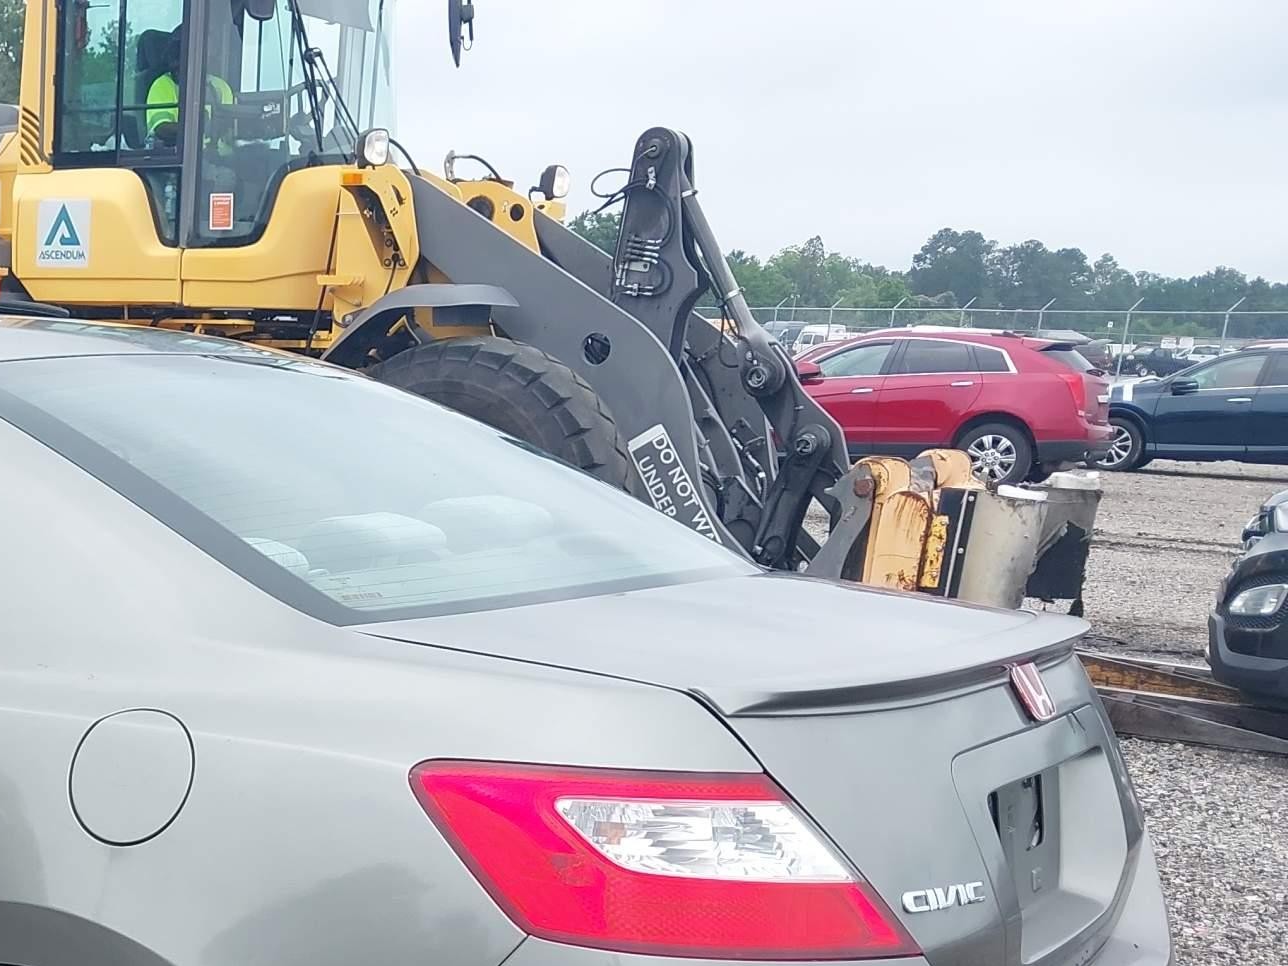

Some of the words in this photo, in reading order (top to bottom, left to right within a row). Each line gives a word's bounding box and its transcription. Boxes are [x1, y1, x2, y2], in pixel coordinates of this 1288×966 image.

[38, 250, 87, 261] ASCENDUM
[652, 434, 675, 464] DO
[668, 466, 699, 507] NOT
[901, 881, 986, 913] CIVIC
